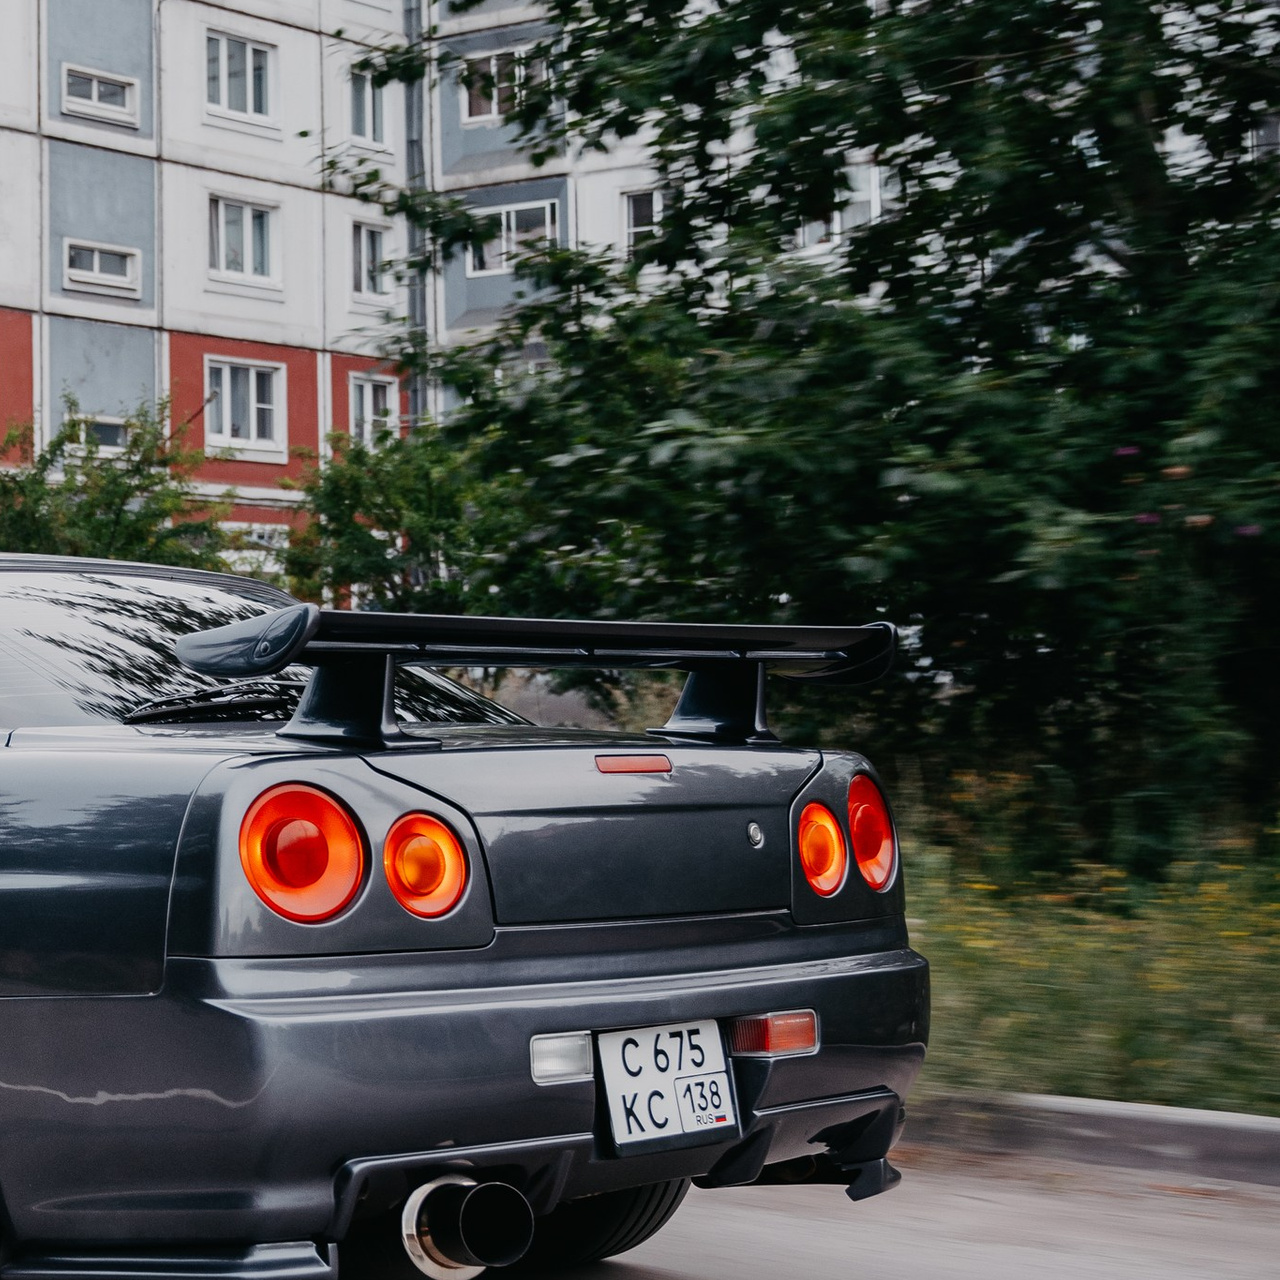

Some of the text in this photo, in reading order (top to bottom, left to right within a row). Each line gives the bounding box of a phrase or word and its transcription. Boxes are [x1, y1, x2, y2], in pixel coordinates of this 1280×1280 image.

[653, 1028, 705, 1073] 675
[683, 1080, 722, 1113] 138
[695, 1114, 715, 1126] RUS
